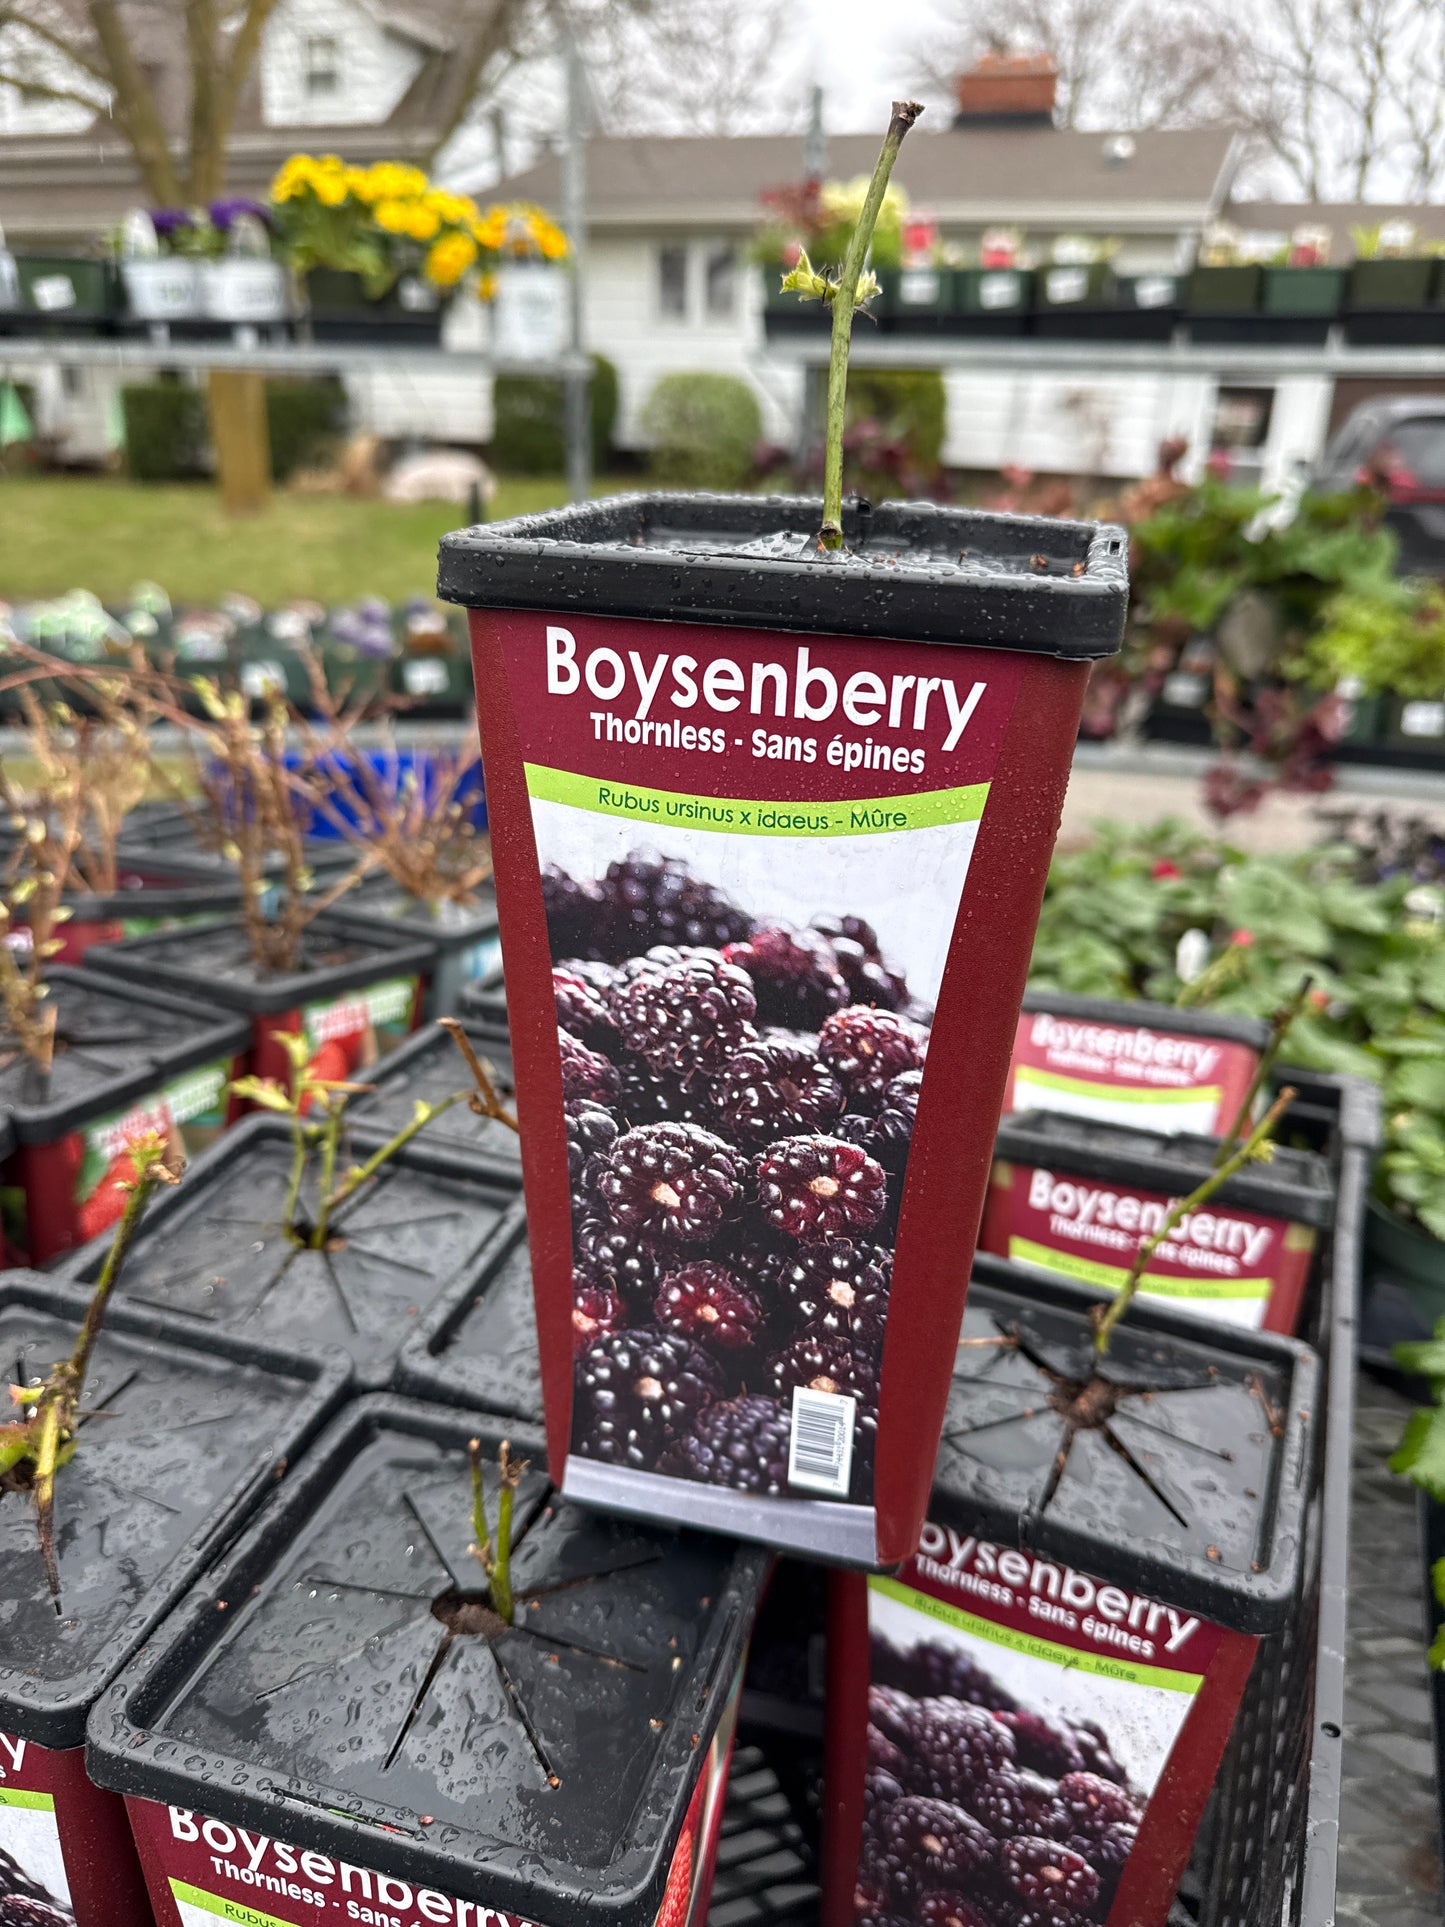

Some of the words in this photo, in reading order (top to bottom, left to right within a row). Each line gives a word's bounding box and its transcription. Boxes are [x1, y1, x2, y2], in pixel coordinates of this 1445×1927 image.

[545, 626, 987, 752] Boysenberry
[590, 712, 726, 753] Thornless
[751, 728, 817, 763] Sans
[826, 734, 926, 774] épines
[599, 787, 660, 813] Rubus
[666, 799, 734, 824] ursinus
[740, 810, 751, 826] x
[757, 808, 829, 830] idaeus
[850, 808, 908, 829] Mûre
[918, 1521, 1200, 1652] oysenberry
[1081, 1614, 1156, 1659] épines
[210, 1855, 326, 1908] Thornless
